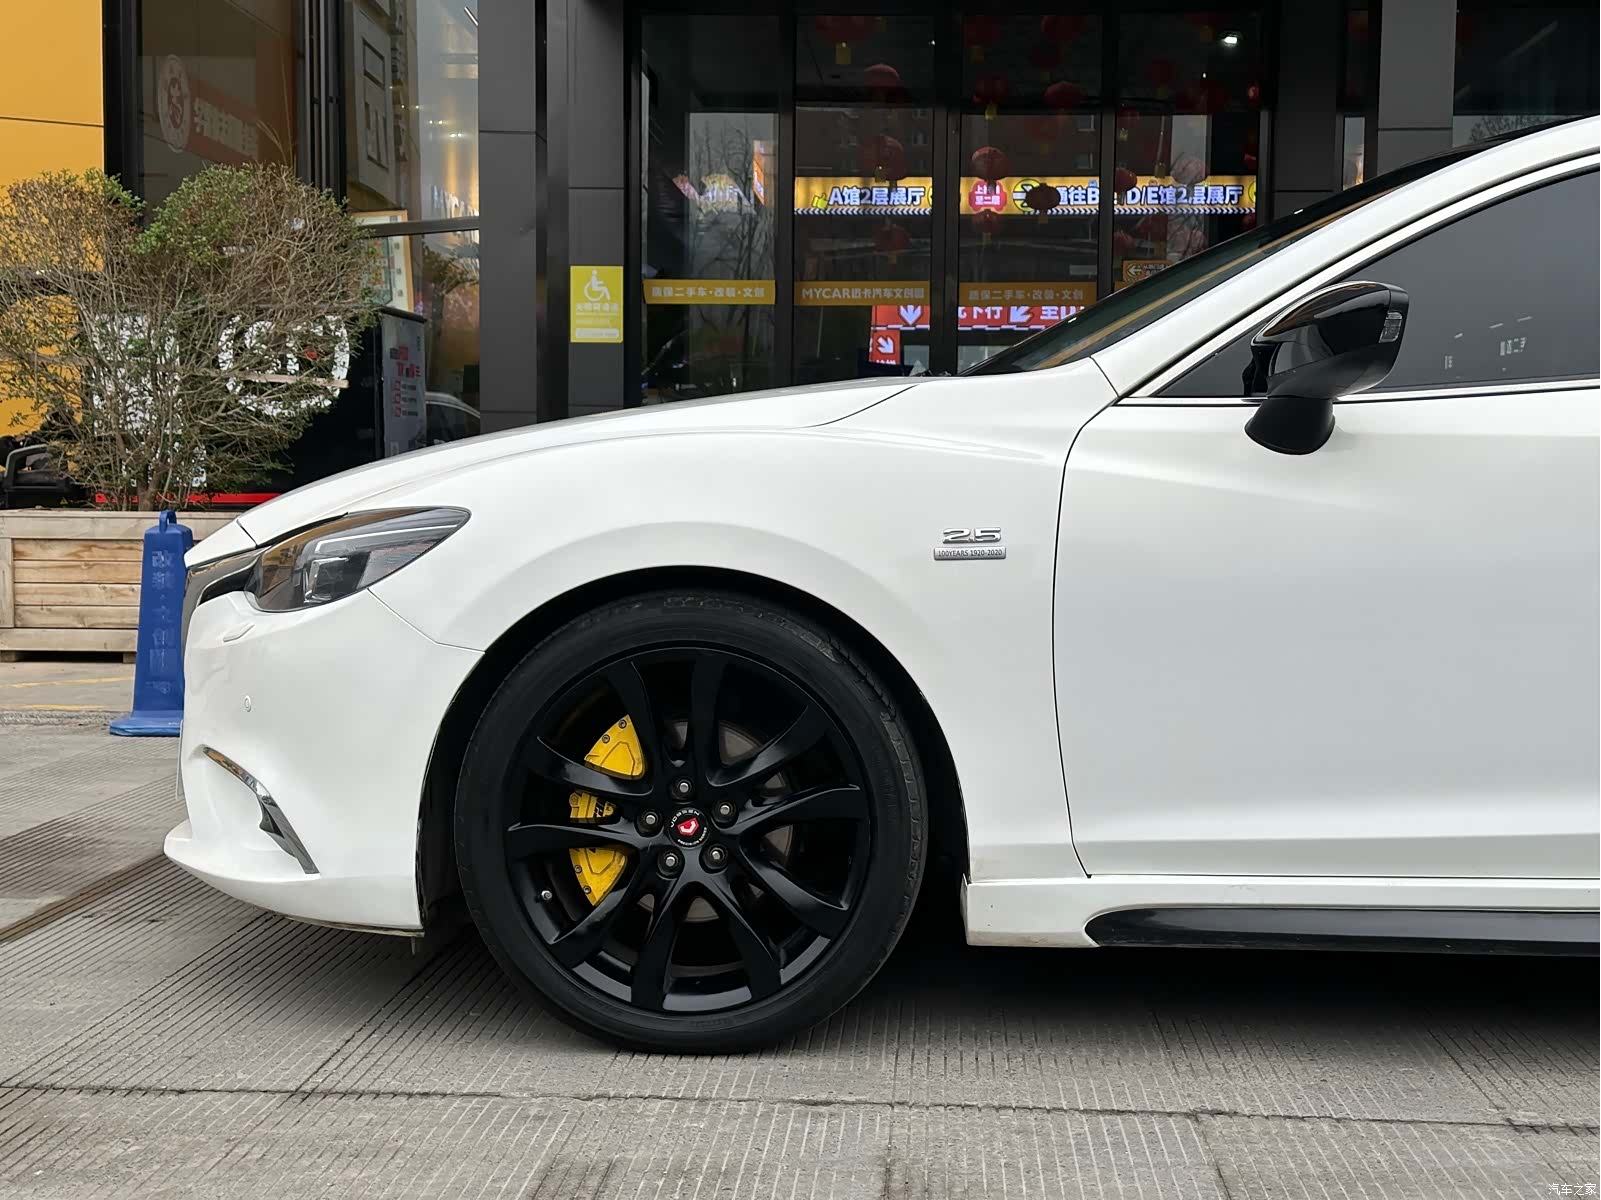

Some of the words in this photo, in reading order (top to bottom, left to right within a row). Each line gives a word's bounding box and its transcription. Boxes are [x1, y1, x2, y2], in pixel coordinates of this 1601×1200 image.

[829, 185, 925, 206] A馆2层展厅
[938, 549, 969, 557] 100YEARS
[970, 548, 1003, 557] 1920-2020
